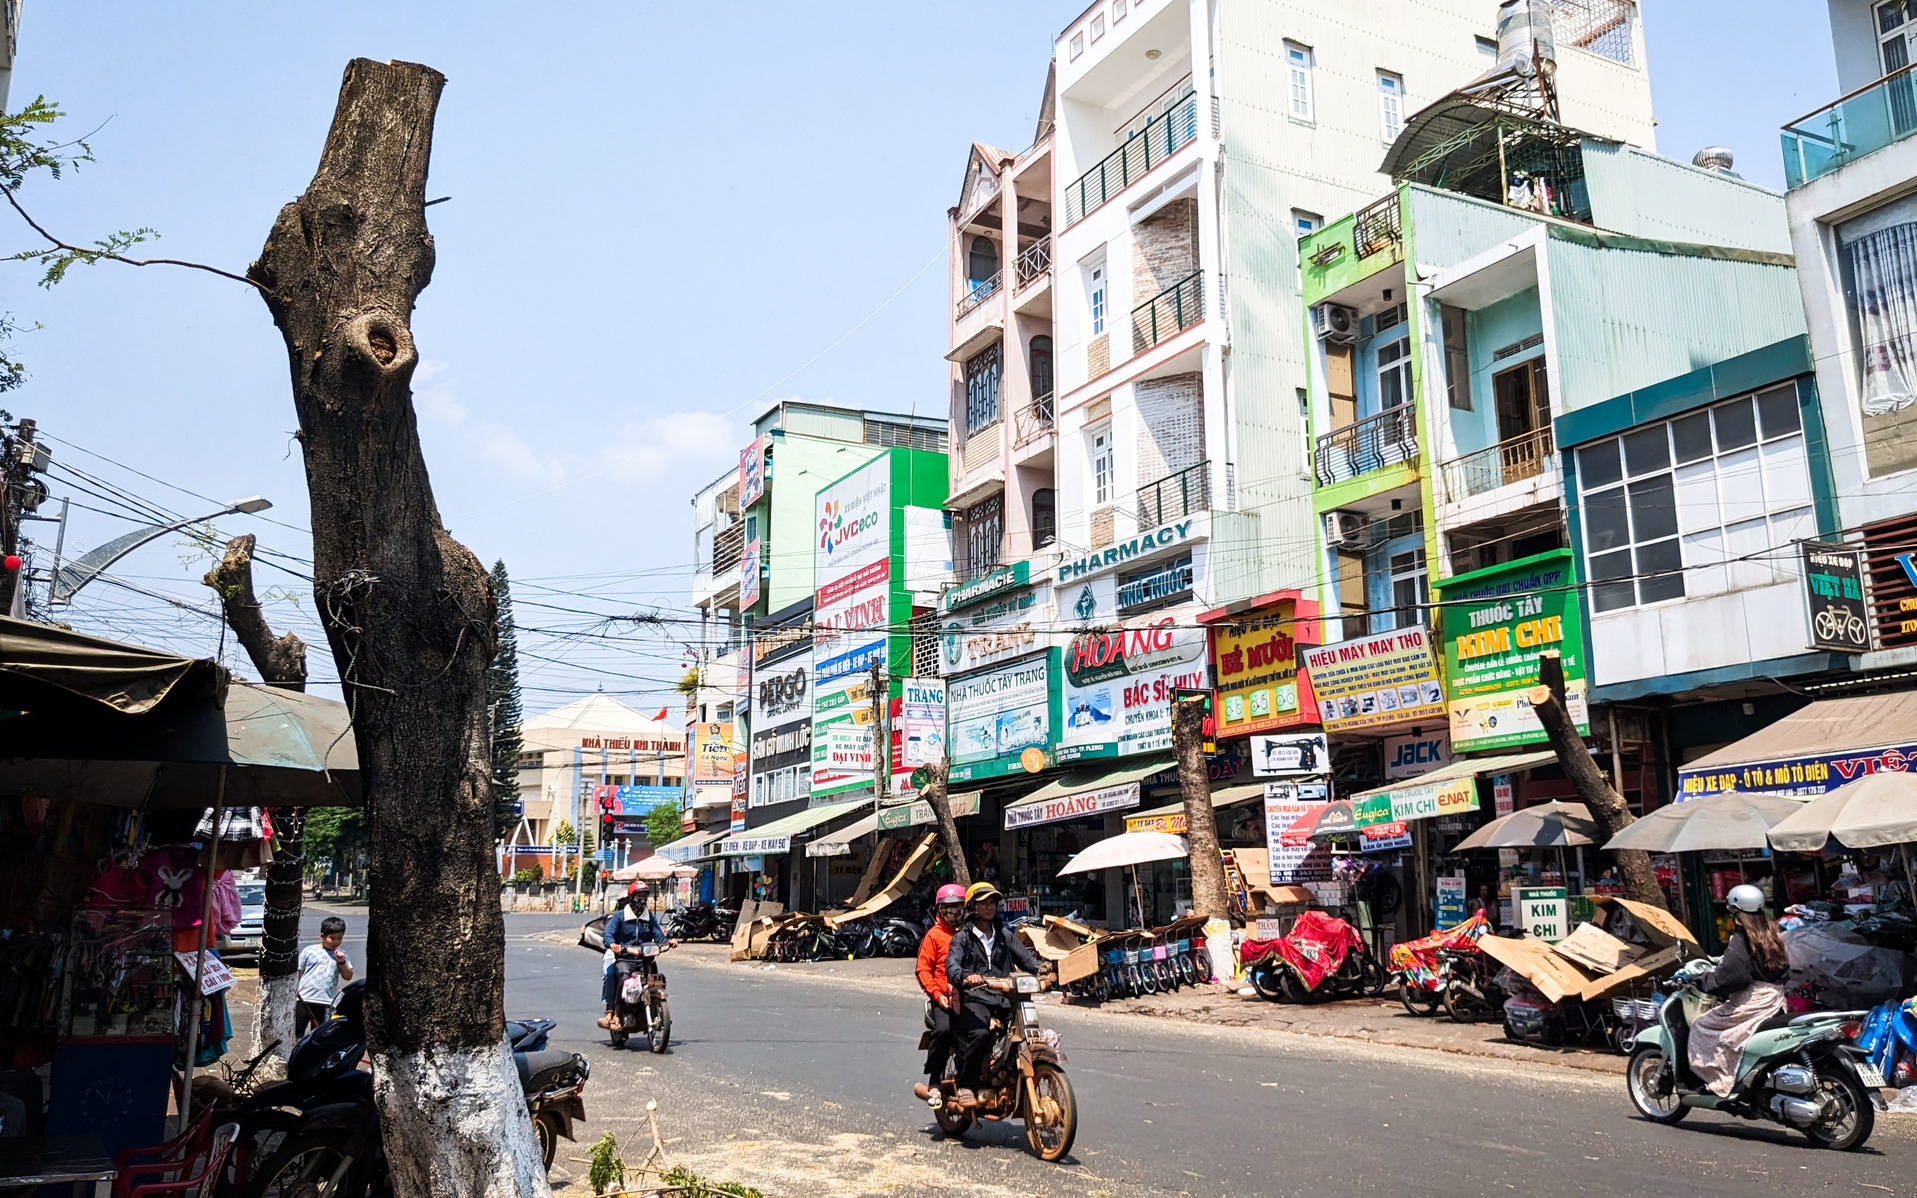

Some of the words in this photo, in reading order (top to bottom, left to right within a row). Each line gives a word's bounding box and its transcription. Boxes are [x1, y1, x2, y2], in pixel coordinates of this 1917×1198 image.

[1059, 519, 1192, 582] PHARMACY
[1810, 551, 1828, 567] HIỆU
[1828, 557, 1838, 566] XE
[1839, 558, 1853, 571] ĐẠP
[951, 571, 1015, 606] PHARMACIE
[1121, 576, 1145, 609] NHÀ
[1149, 561, 1187, 600] THUỐC
[1513, 573, 1541, 591] CHUẨN
[1543, 570, 1560, 585] GPP
[1809, 569, 1840, 600] VIỆT
[1842, 574, 1861, 600] HÀ
[844, 595, 885, 632] VINH
[1469, 601, 1513, 628] THUỐC
[1516, 596, 1543, 618] TÂY
[968, 621, 1035, 660] TRANG
[1072, 617, 1174, 673] HOÀNG
[1309, 650, 1337, 669] HIỆU
[1339, 643, 1365, 662] MÁY
[1368, 637, 1395, 656] MAY
[1397, 632, 1422, 650] THỌ
[1456, 627, 1511, 660] KIM
[1515, 615, 1563, 648] CHI
[1221, 644, 1244, 676] BÉ
[1246, 631, 1295, 670] MƯỜI
[760, 667, 806, 710] PERGO
[907, 687, 944, 704] TRANG
[951, 685, 967, 703] NHÀ
[968, 676, 996, 699] THUỐC
[997, 674, 1013, 691] TÂY
[1014, 666, 1045, 687] TRANG
[1124, 679, 1149, 709] BÁC
[1145, 709, 1159, 722] KHOA
[582, 735, 601, 749] NHÀ
[603, 735, 631, 750] THIẾU
[633, 739, 648, 750] NHI
[650, 733, 681, 751] THÀNH
[753, 736, 766, 760] SÀN
[767, 728, 776, 757] GỖ
[776, 730, 794, 755] MINH
[794, 723, 812, 753] LỘC
[832, 752, 848, 765] ĐẠI
[849, 752, 871, 763] VINH
[1683, 774, 1704, 796] HIỆU
[1706, 776, 1718, 792] XE
[1719, 773, 1737, 792] ĐẠP
[1743, 768, 1751, 788] Ô
[1751, 767, 1763, 787] TÔ
[1765, 769, 1773, 785] &
[1774, 764, 1790, 785] MÔ
[1791, 763, 1804, 783] TÔ
[1804, 760, 1829, 784] ĐIỆN
[1392, 792, 1404, 800] NHÀ
[1404, 788, 1424, 798] THUỐC
[1424, 786, 1434, 795] TÂY
[1438, 790, 1470, 806] ENAT
[915, 807, 933, 820] TRAN
[1046, 796, 1097, 819] HOÀNG
[1354, 808, 1389, 822] Eugica
[1393, 802, 1414, 818] KIM
[1418, 798, 1436, 814] CHI
[1006, 899, 1027, 911] TRANG
[1531, 904, 1557, 917] KIM
[1532, 923, 1557, 938] CHI
[204, 977, 218, 988] CÁI
[217, 972, 232, 983] 100K
